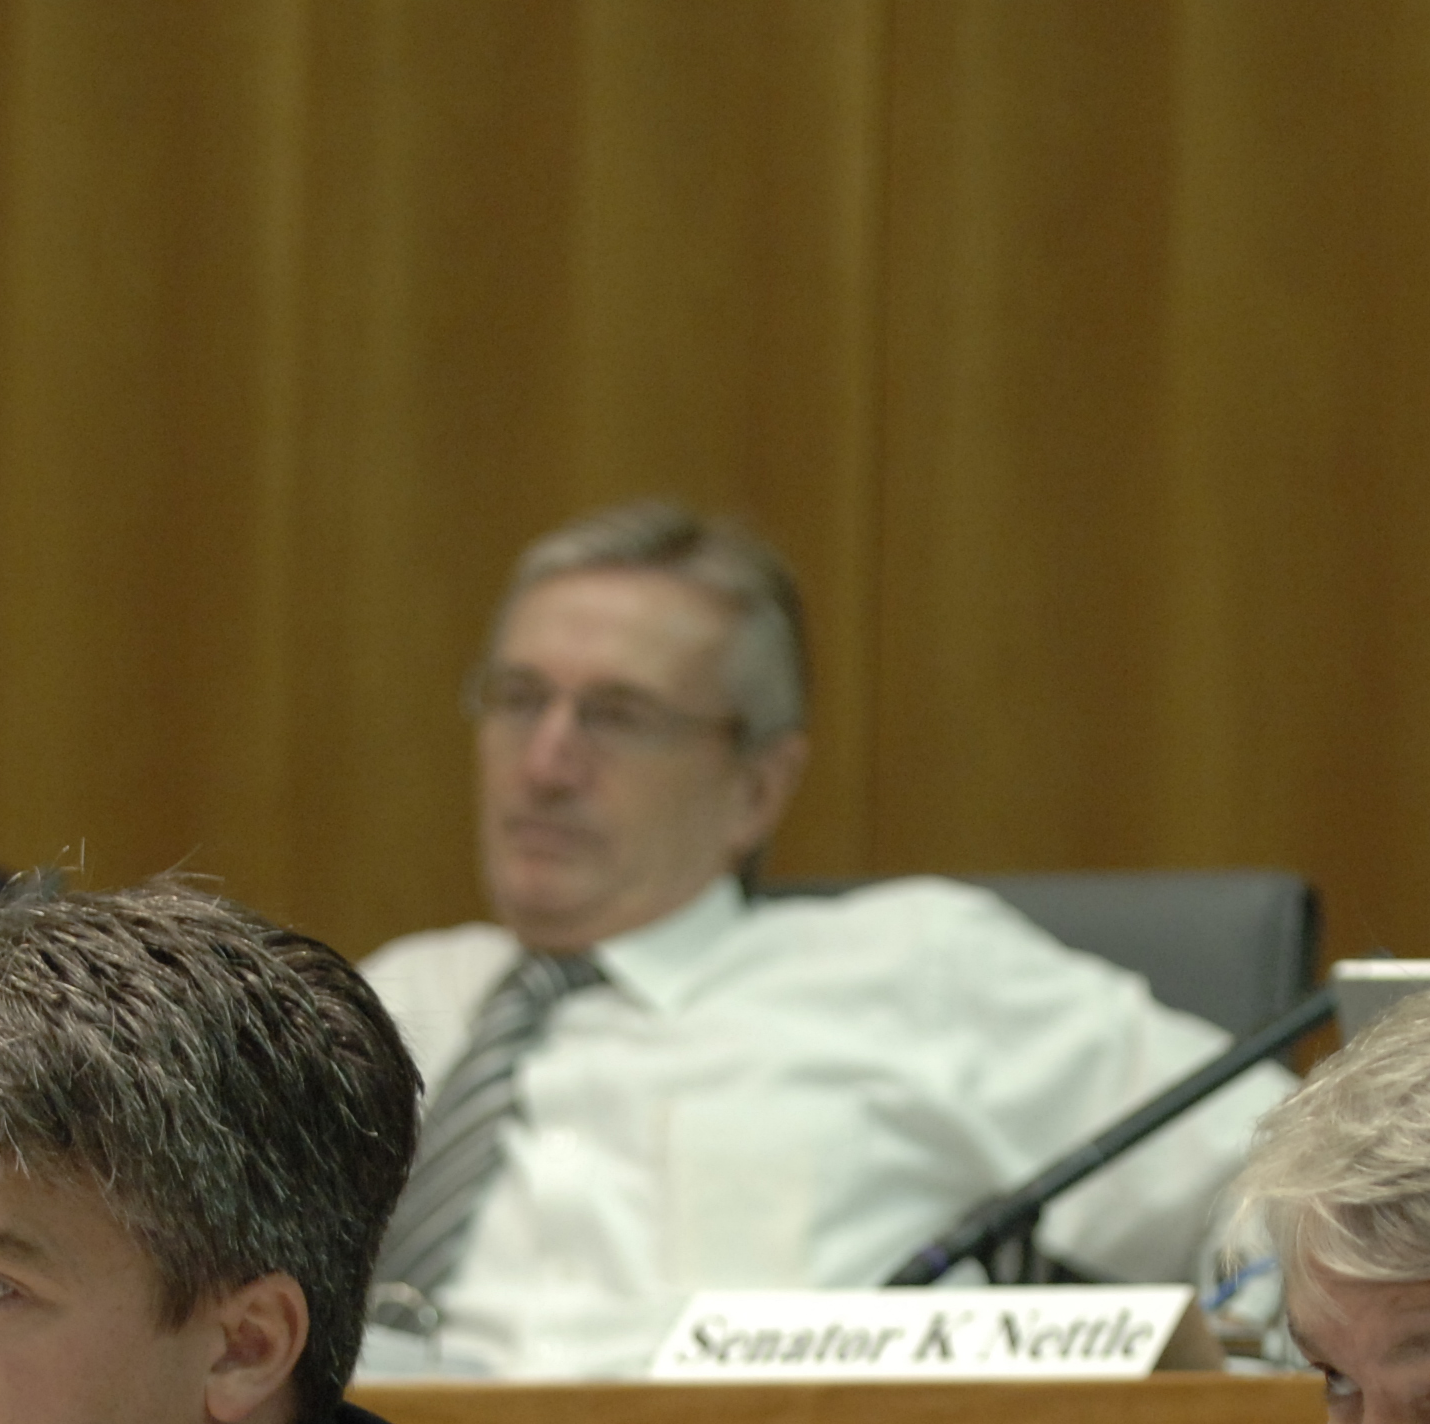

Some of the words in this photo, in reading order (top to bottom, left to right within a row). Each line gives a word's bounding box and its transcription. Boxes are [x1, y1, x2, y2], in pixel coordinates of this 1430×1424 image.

[676, 1312, 902, 1366] Senator
[909, 1309, 973, 1363] K
[979, 1307, 1155, 1362] Nettle
